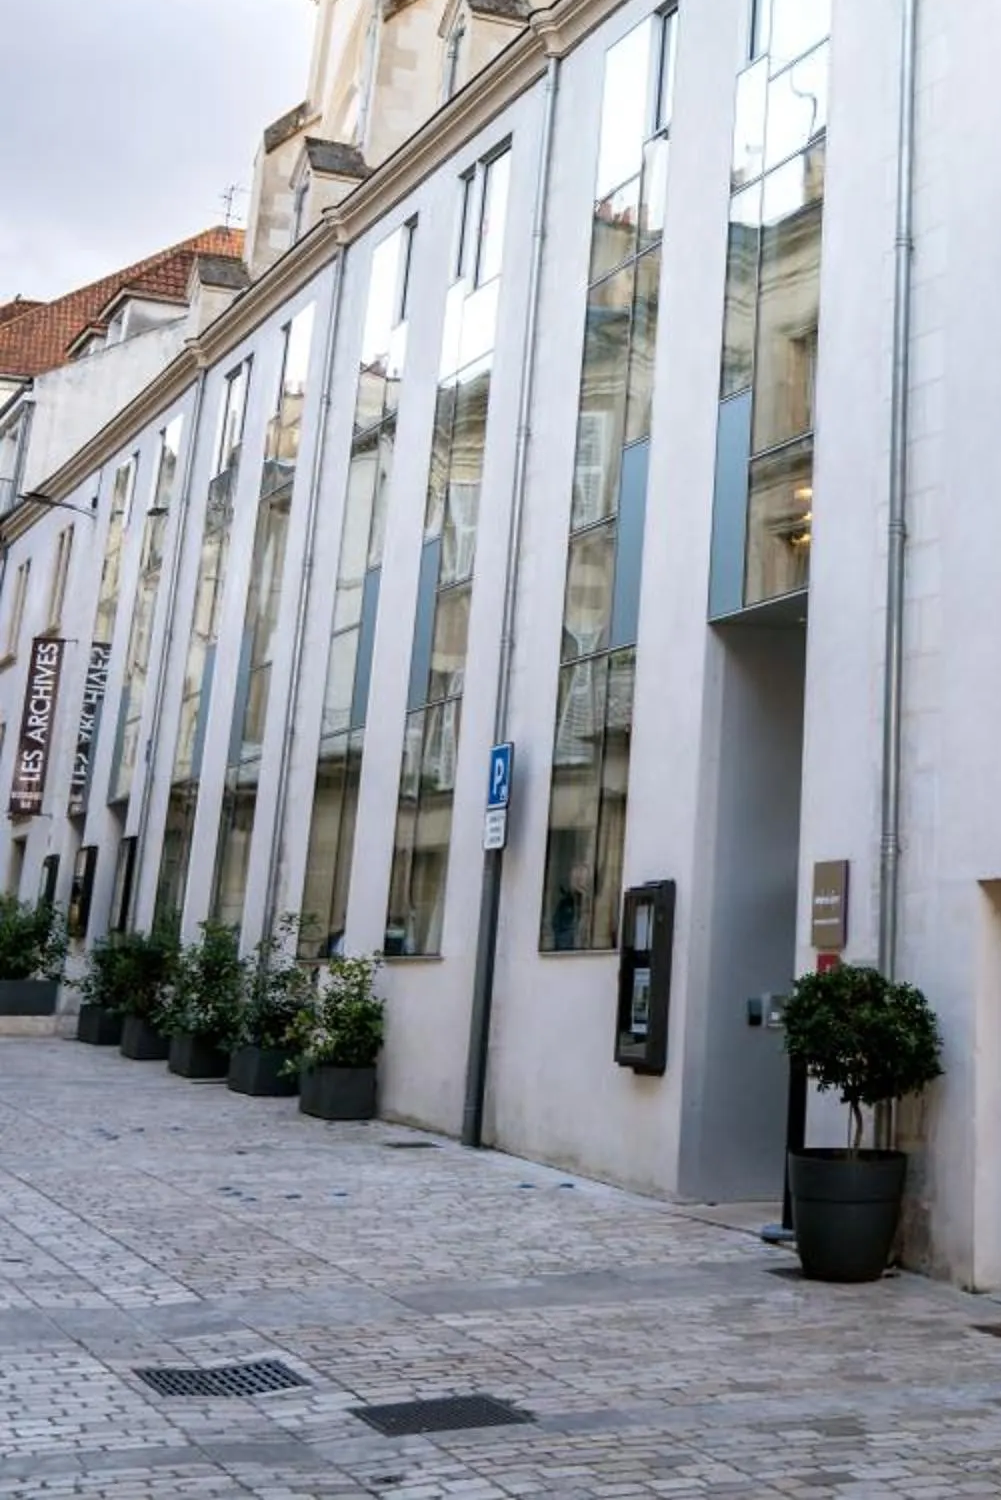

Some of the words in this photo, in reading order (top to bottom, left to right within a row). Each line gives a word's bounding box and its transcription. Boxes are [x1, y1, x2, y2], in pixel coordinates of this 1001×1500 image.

[25, 643, 59, 743] ARCHIVES
[20, 750, 43, 782] LES
[493, 758, 504, 795] P
